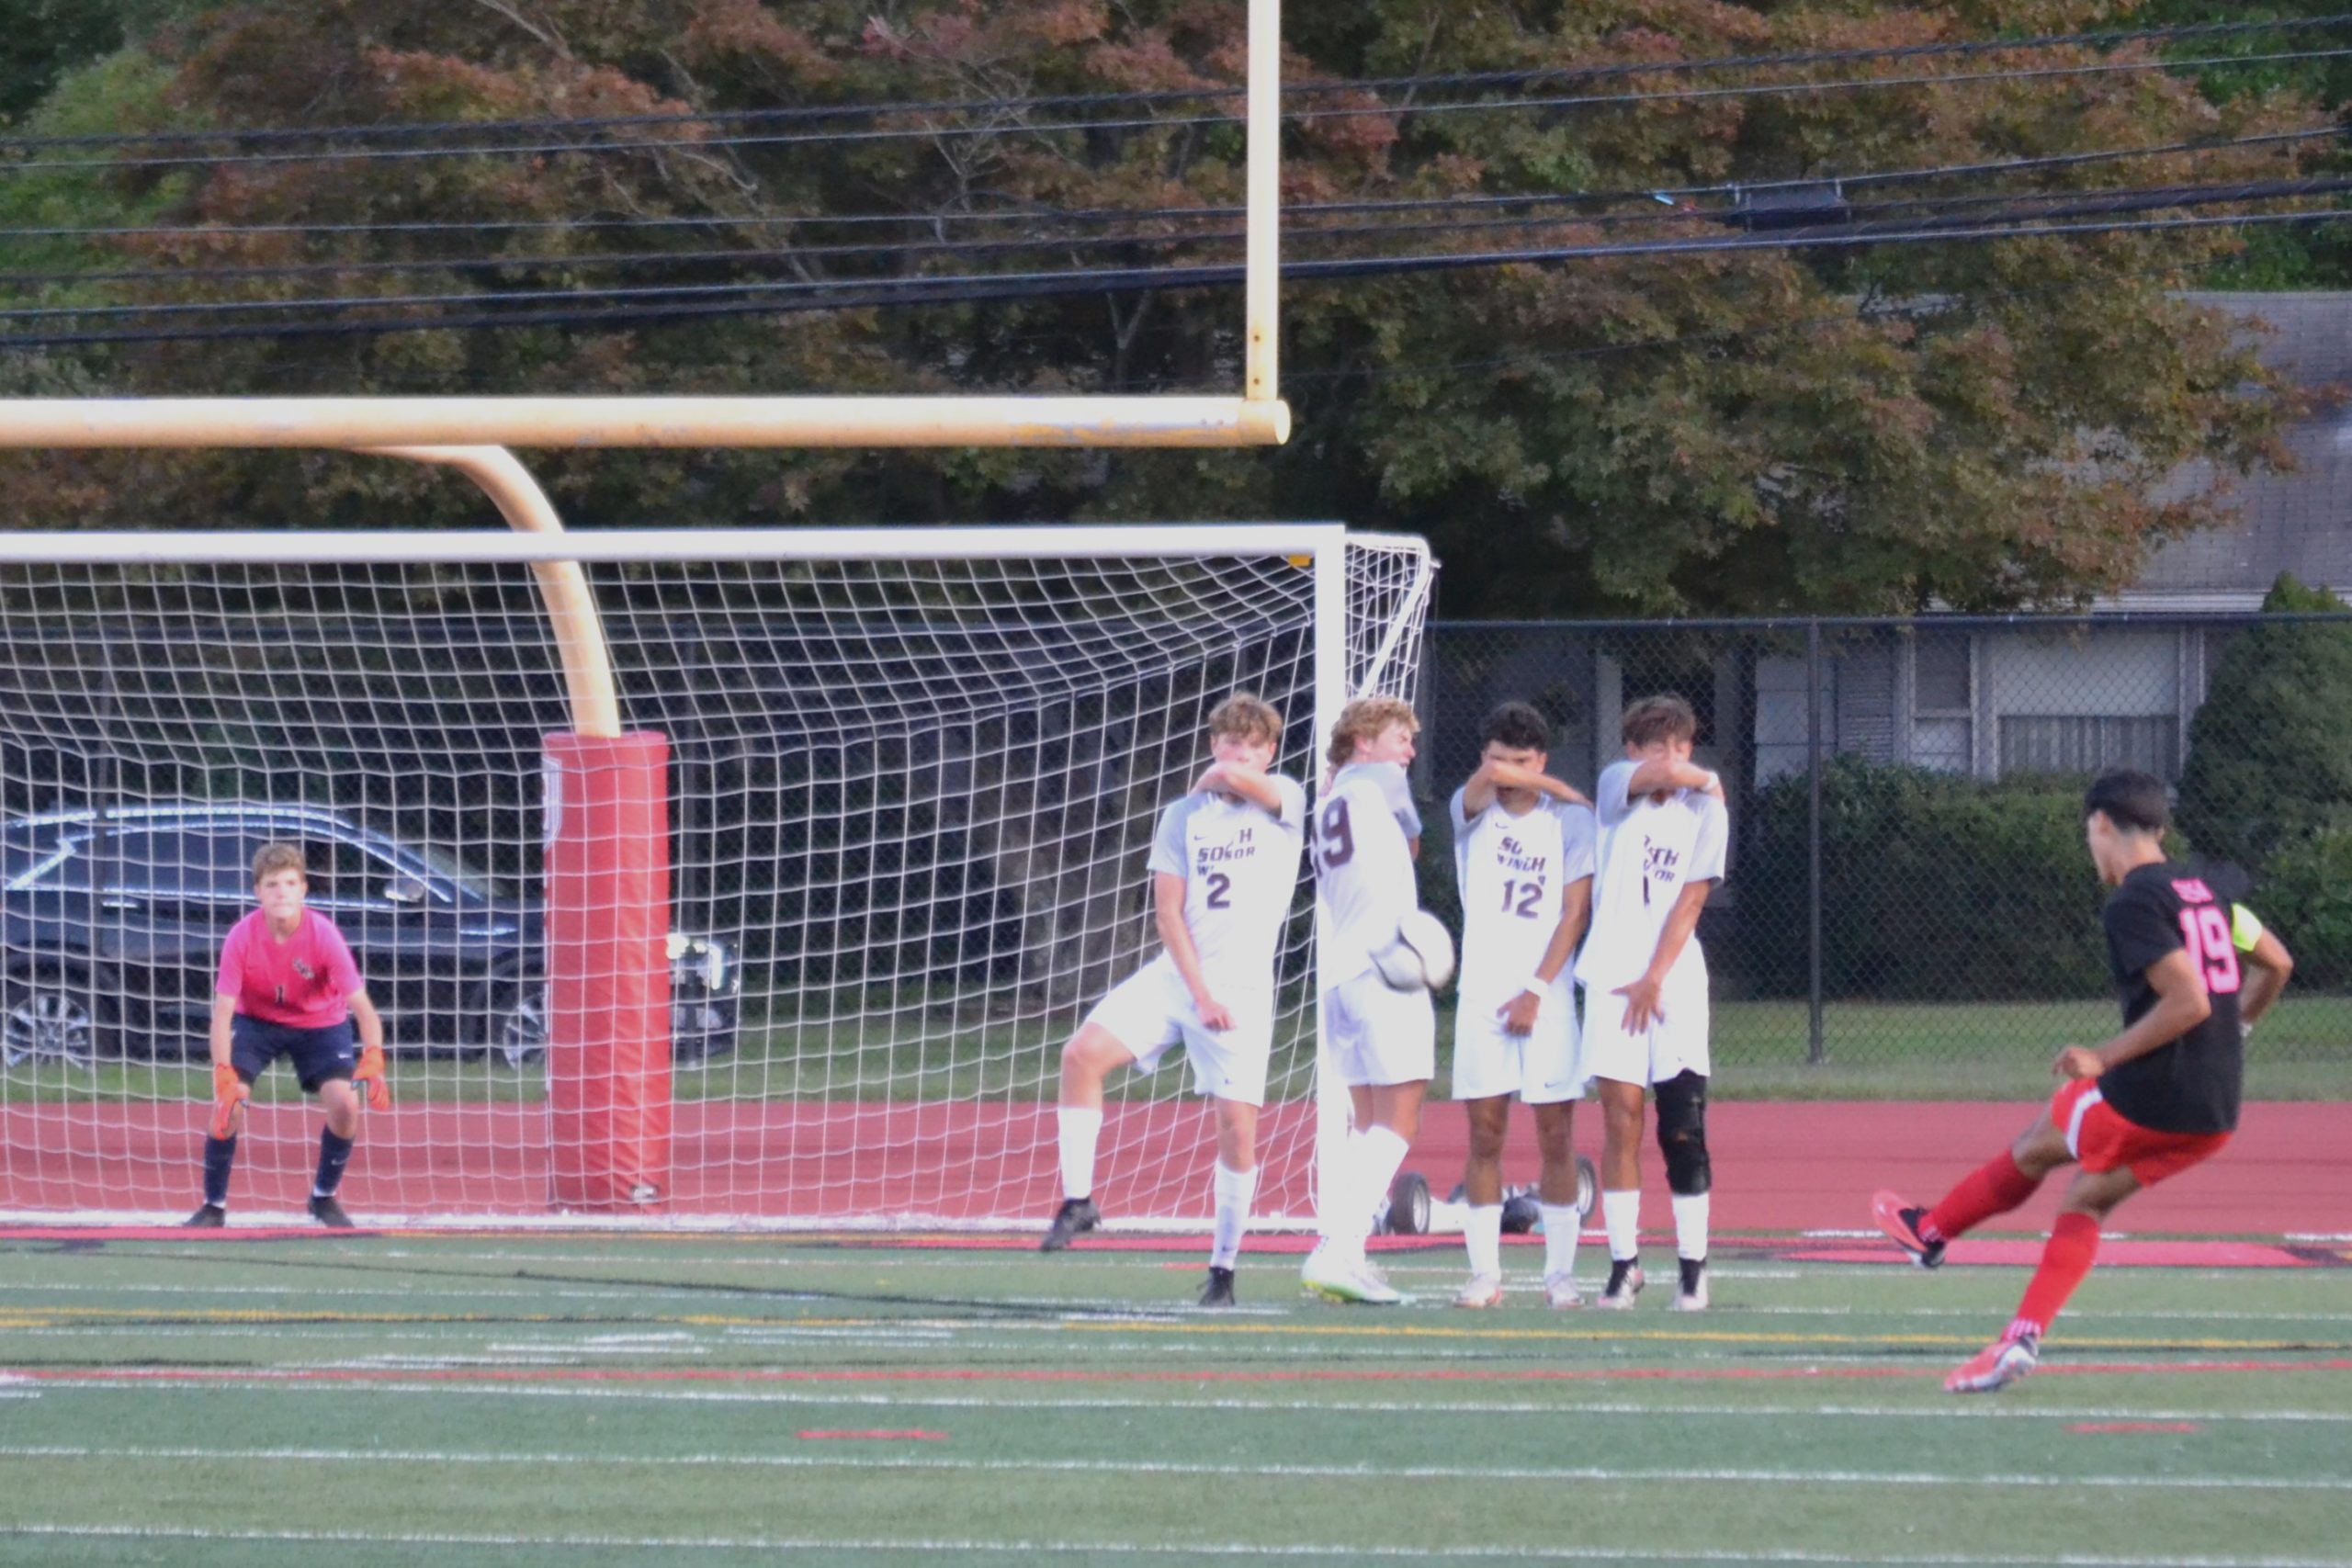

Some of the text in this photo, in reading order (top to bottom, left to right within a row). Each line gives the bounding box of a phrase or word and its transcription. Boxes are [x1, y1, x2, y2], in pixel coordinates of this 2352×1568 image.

[1206, 873, 1231, 910] 2
[1501, 879, 1543, 919] 12
[2178, 904, 2242, 995] 19
